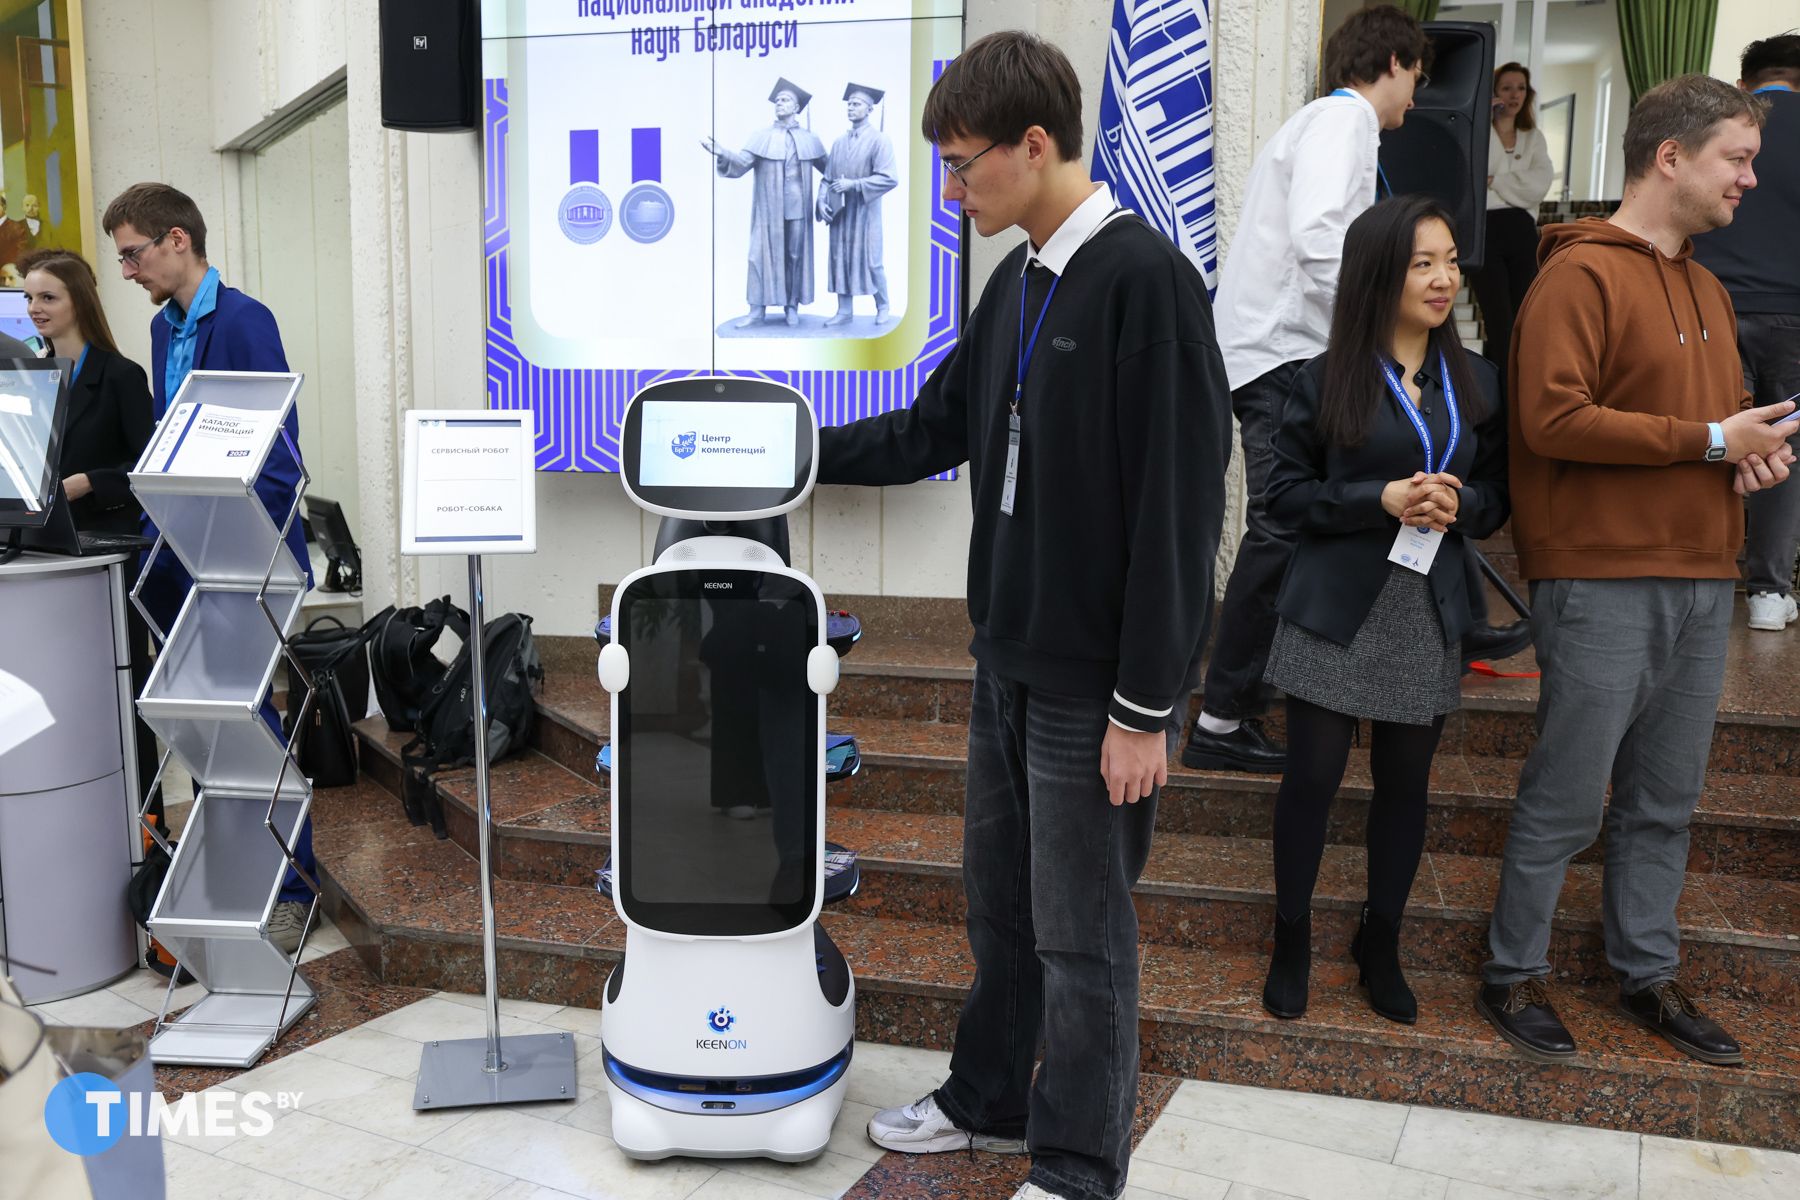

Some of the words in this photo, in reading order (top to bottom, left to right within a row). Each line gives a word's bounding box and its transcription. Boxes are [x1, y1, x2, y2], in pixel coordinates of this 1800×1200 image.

[632, 26, 680, 61] наук
[695, 17, 797, 57] Беларуси
[202, 418, 240, 427] КАТАЛОГ
[198, 424, 255, 435] ИННОВАЦИЙ
[701, 434, 731, 444] Центр
[701, 446, 766, 454] компетенций
[696, 1039, 746, 1049] KEENON
